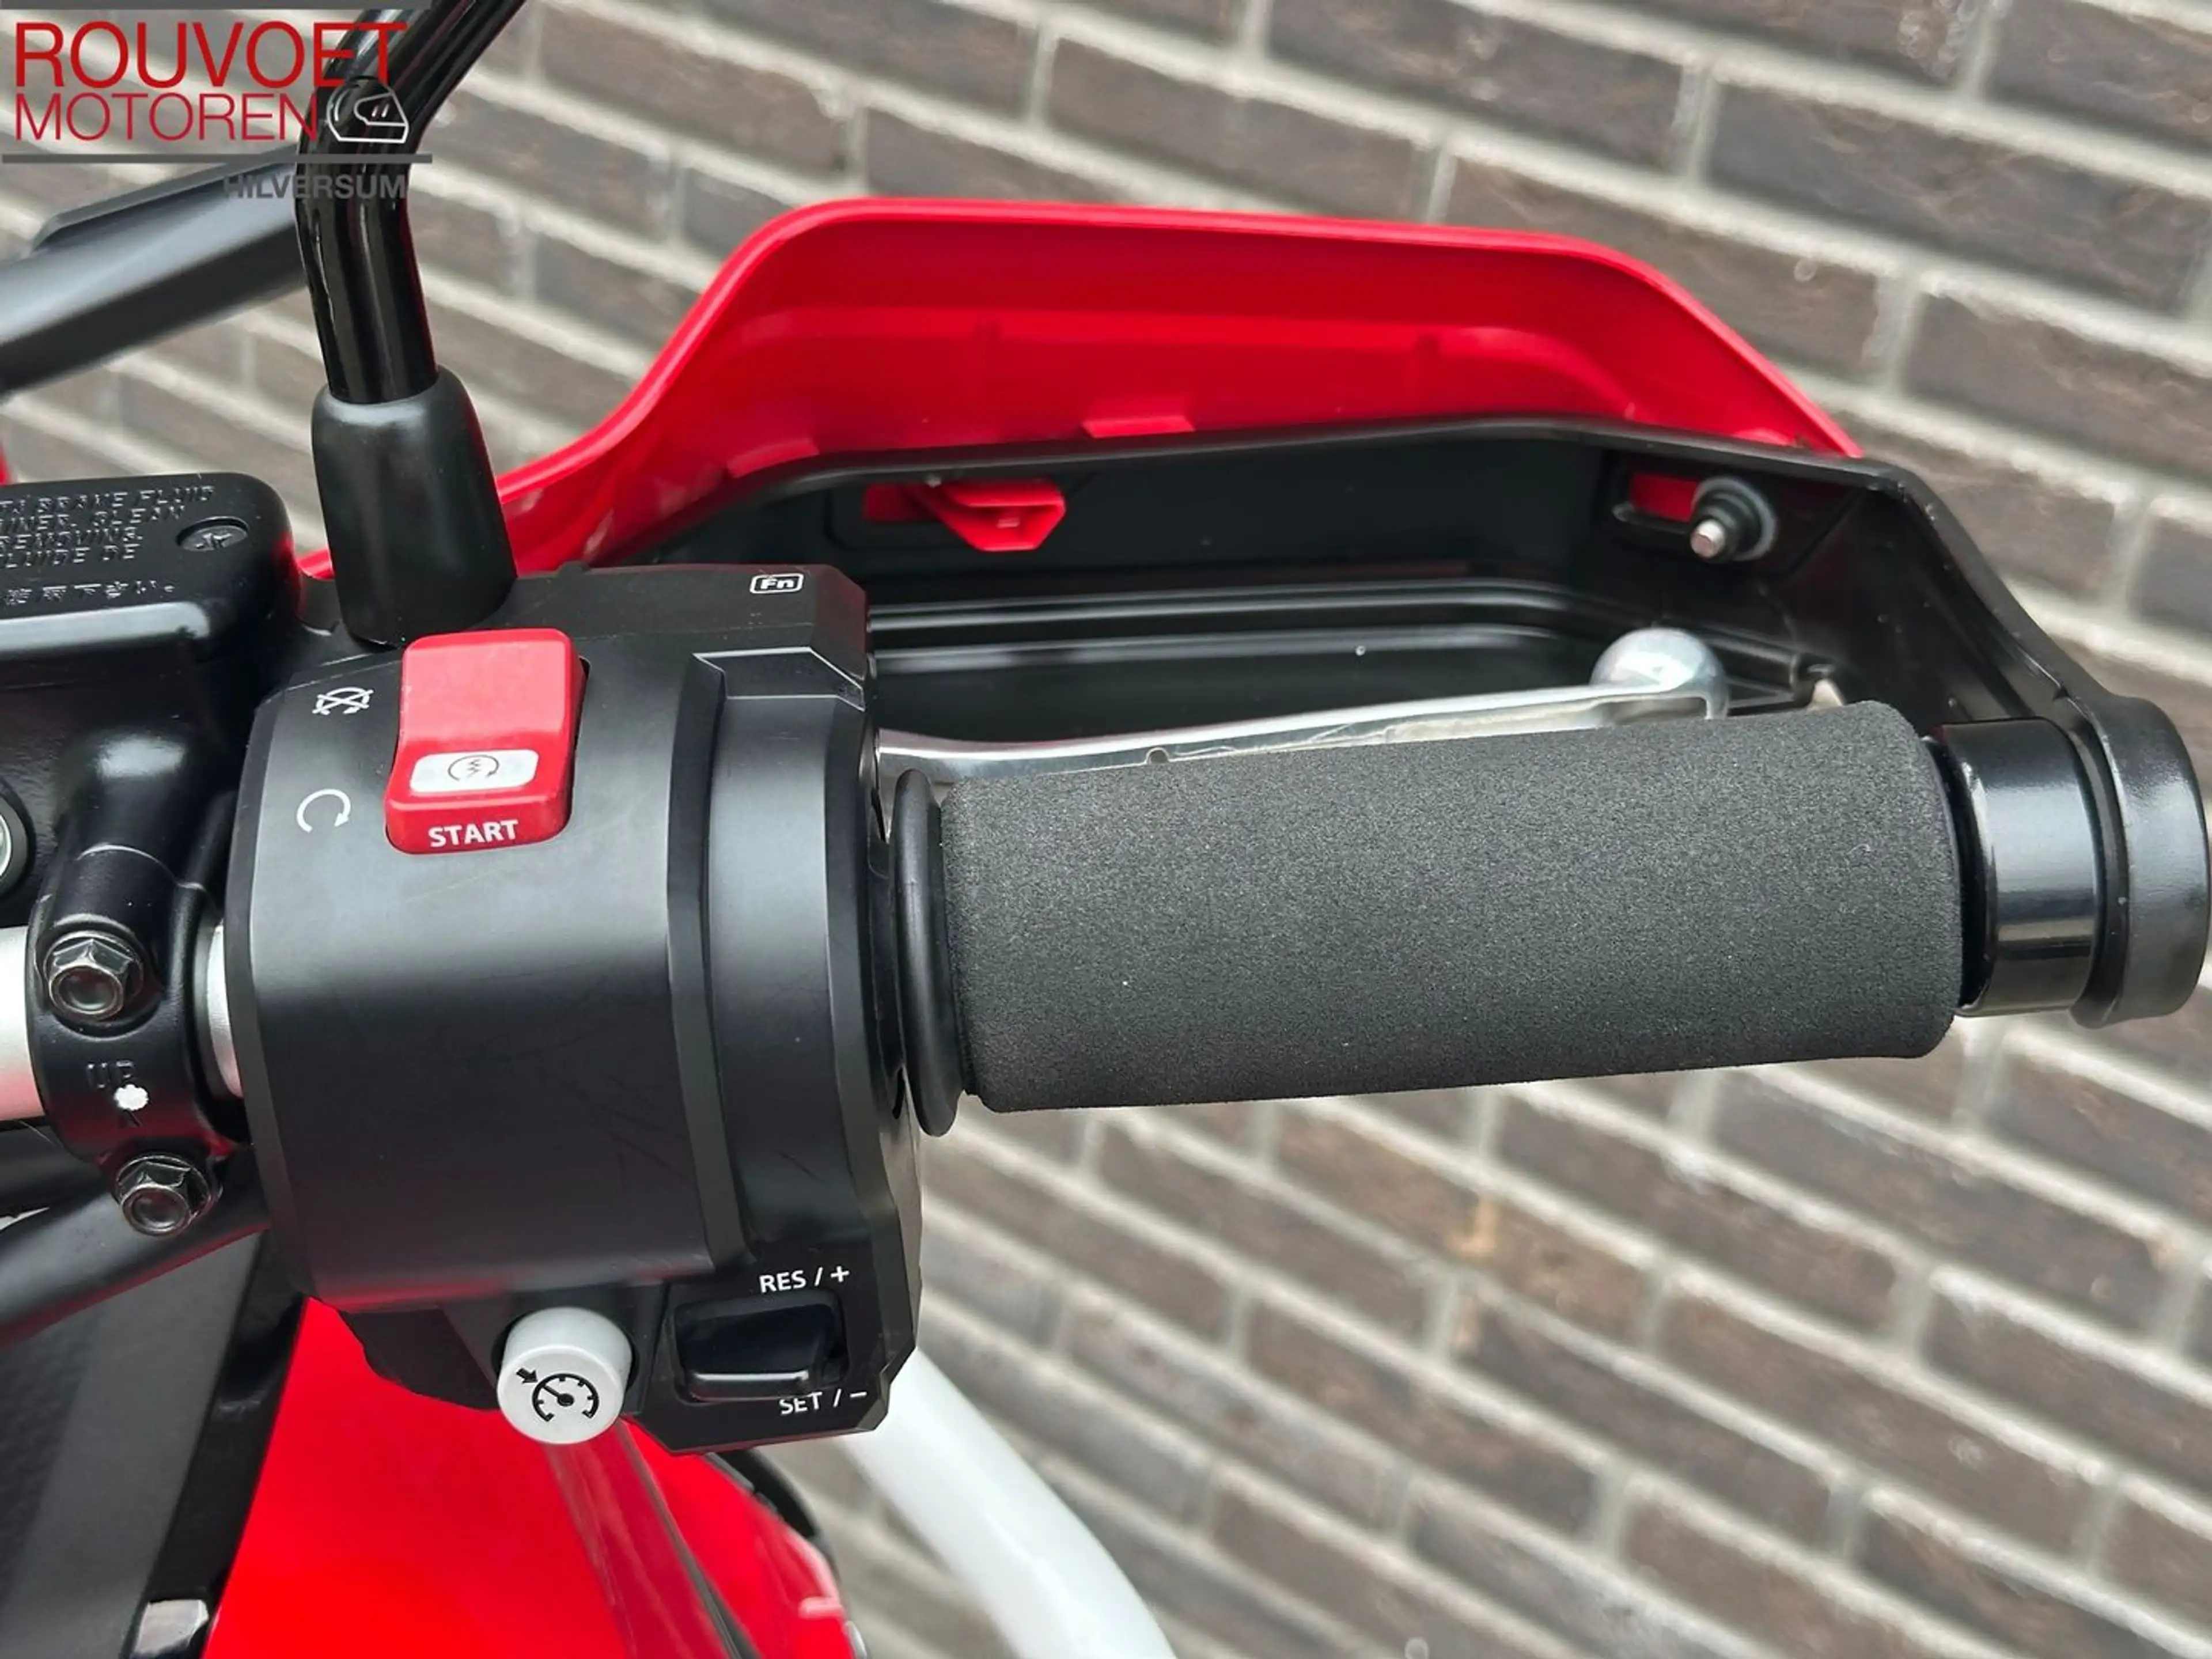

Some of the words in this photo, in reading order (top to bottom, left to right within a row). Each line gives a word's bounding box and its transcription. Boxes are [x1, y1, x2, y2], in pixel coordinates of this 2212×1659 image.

[759, 578, 794, 590] Fn
[428, 819, 518, 847] START
[86, 1060, 136, 1089] UP
[758, 1270, 806, 1293] RES
[779, 1391, 823, 1415] SET
